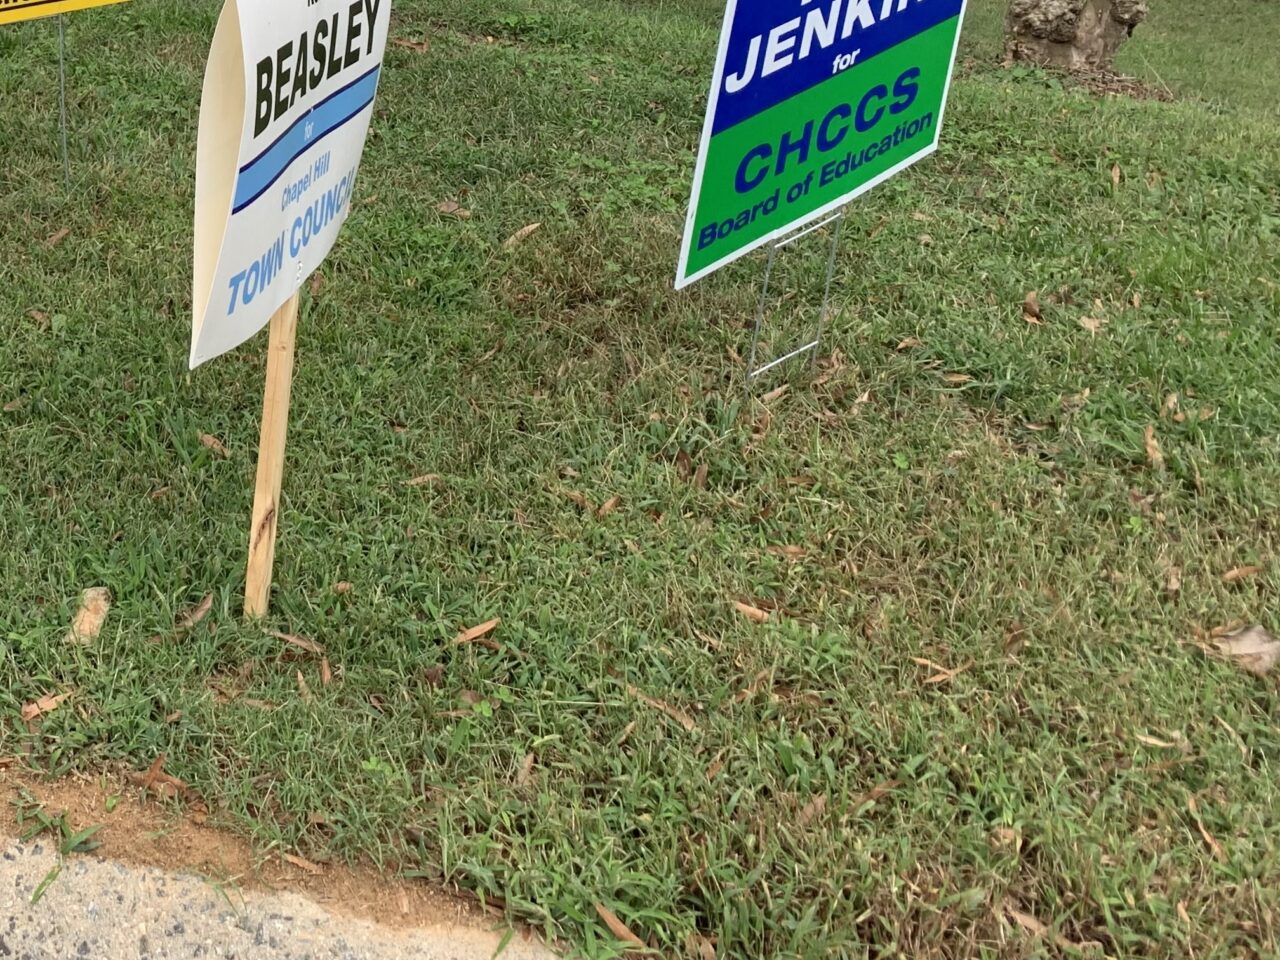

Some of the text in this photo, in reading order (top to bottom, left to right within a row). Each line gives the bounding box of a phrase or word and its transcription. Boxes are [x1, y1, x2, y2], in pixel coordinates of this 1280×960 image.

[832, 48, 861, 74] for
[304, 120, 314, 142] for
[734, 66, 920, 193] CHCCS
[281, 150, 331, 211] Chapel Hill
[697, 112, 933, 251] Board of Education
[227, 229, 286, 316] TOWN
